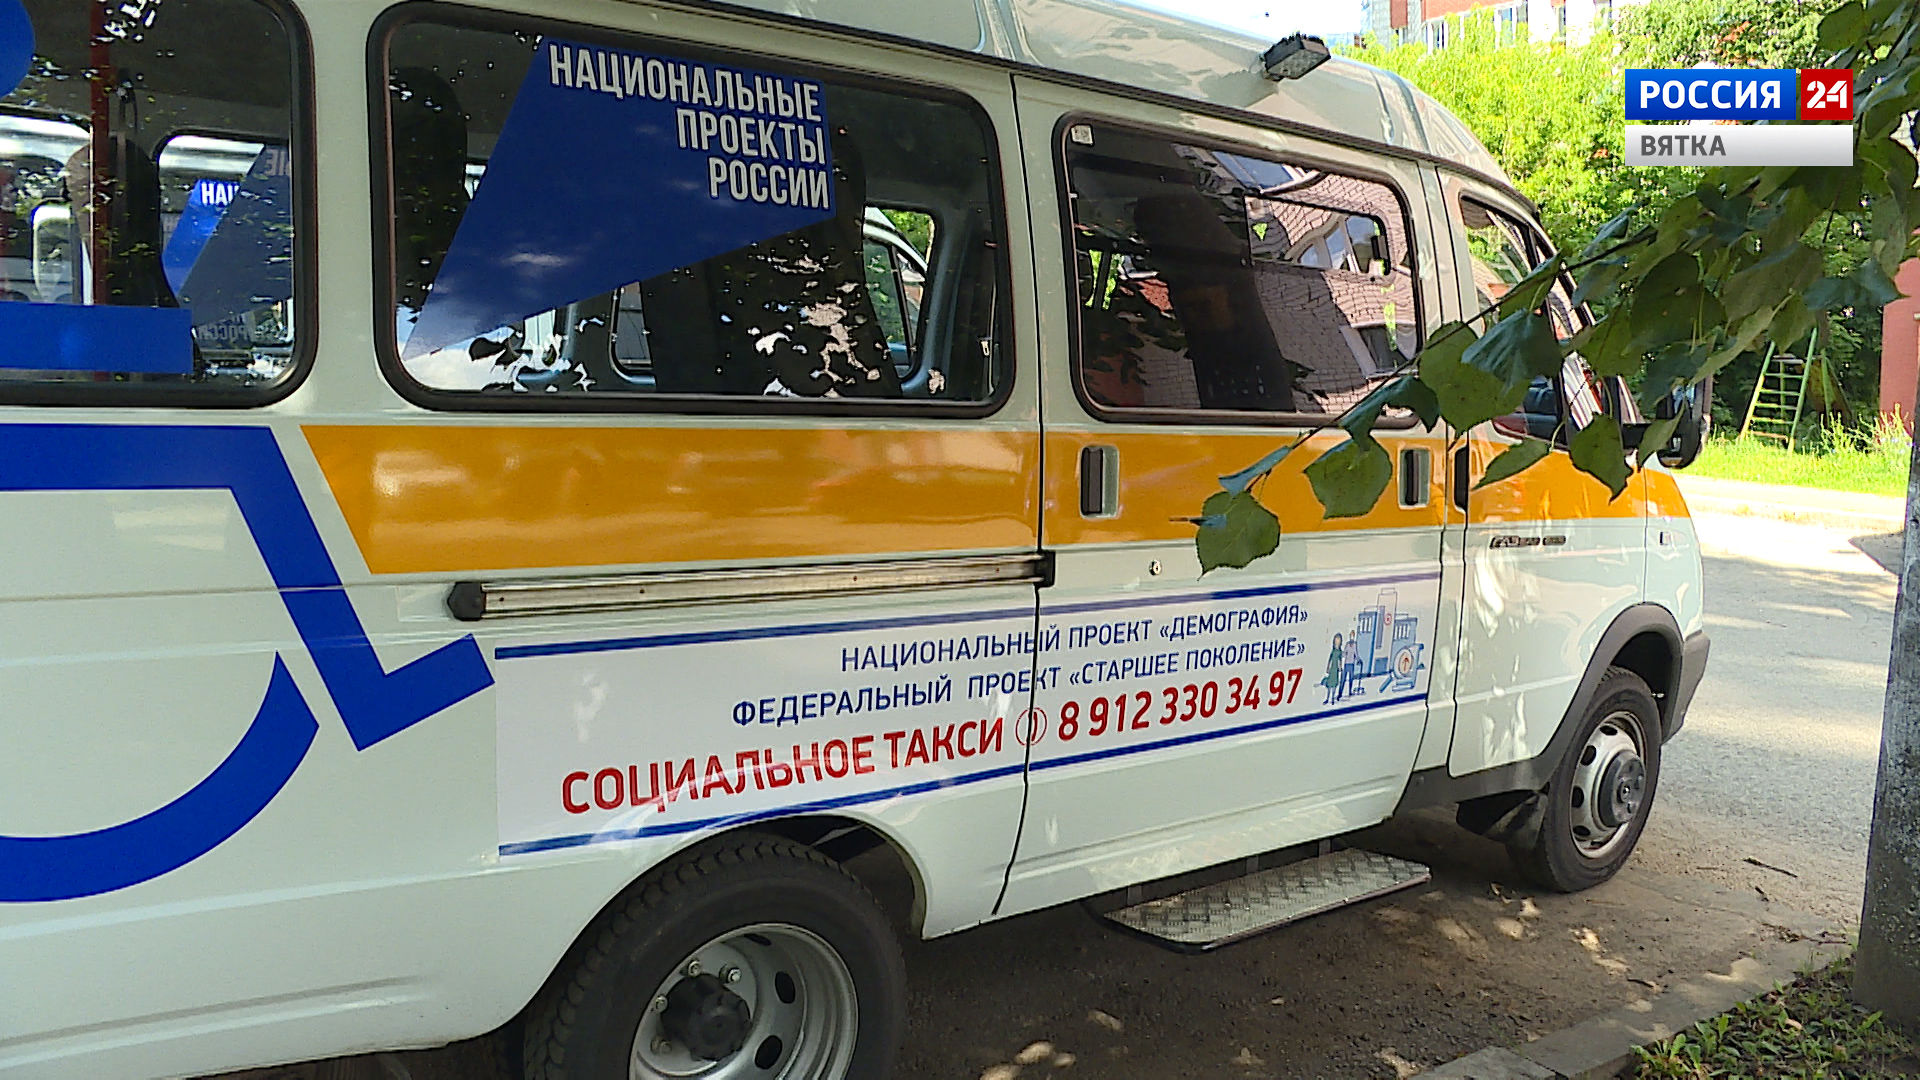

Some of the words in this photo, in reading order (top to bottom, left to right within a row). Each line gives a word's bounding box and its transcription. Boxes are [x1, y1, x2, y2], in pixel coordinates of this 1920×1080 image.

[549, 44, 822, 122] НАЦИОНАЛЬНЫЕ
[676, 108, 826, 165] ПРОЕКТЫ
[708, 157, 830, 209] РОССИИ
[841, 623, 1060, 672] НАЦИОНАЛЬНЫЙ
[1068, 619, 1152, 649] ПРОЕКТ
[1159, 604, 1309, 642] «ДЕМОГРАФИЯ»
[732, 674, 953, 727] ФЕДЕРАЛЬНЫЙ
[968, 666, 1062, 699] ПРОЕКТ
[1069, 652, 1180, 686] «СТАРШЕЕ
[1185, 636, 1306, 670] ПОКОЛЕНИЕ»
[562, 734, 876, 815] СОЦИАЛЬНОЕ
[882, 716, 1004, 769] ТАКСИ
[1058, 700, 1080, 742] 8
[1088, 690, 1153, 737] 912
[1159, 680, 1219, 726] 330
[1224, 674, 1261, 715] 34
[1267, 667, 1304, 707] 97
